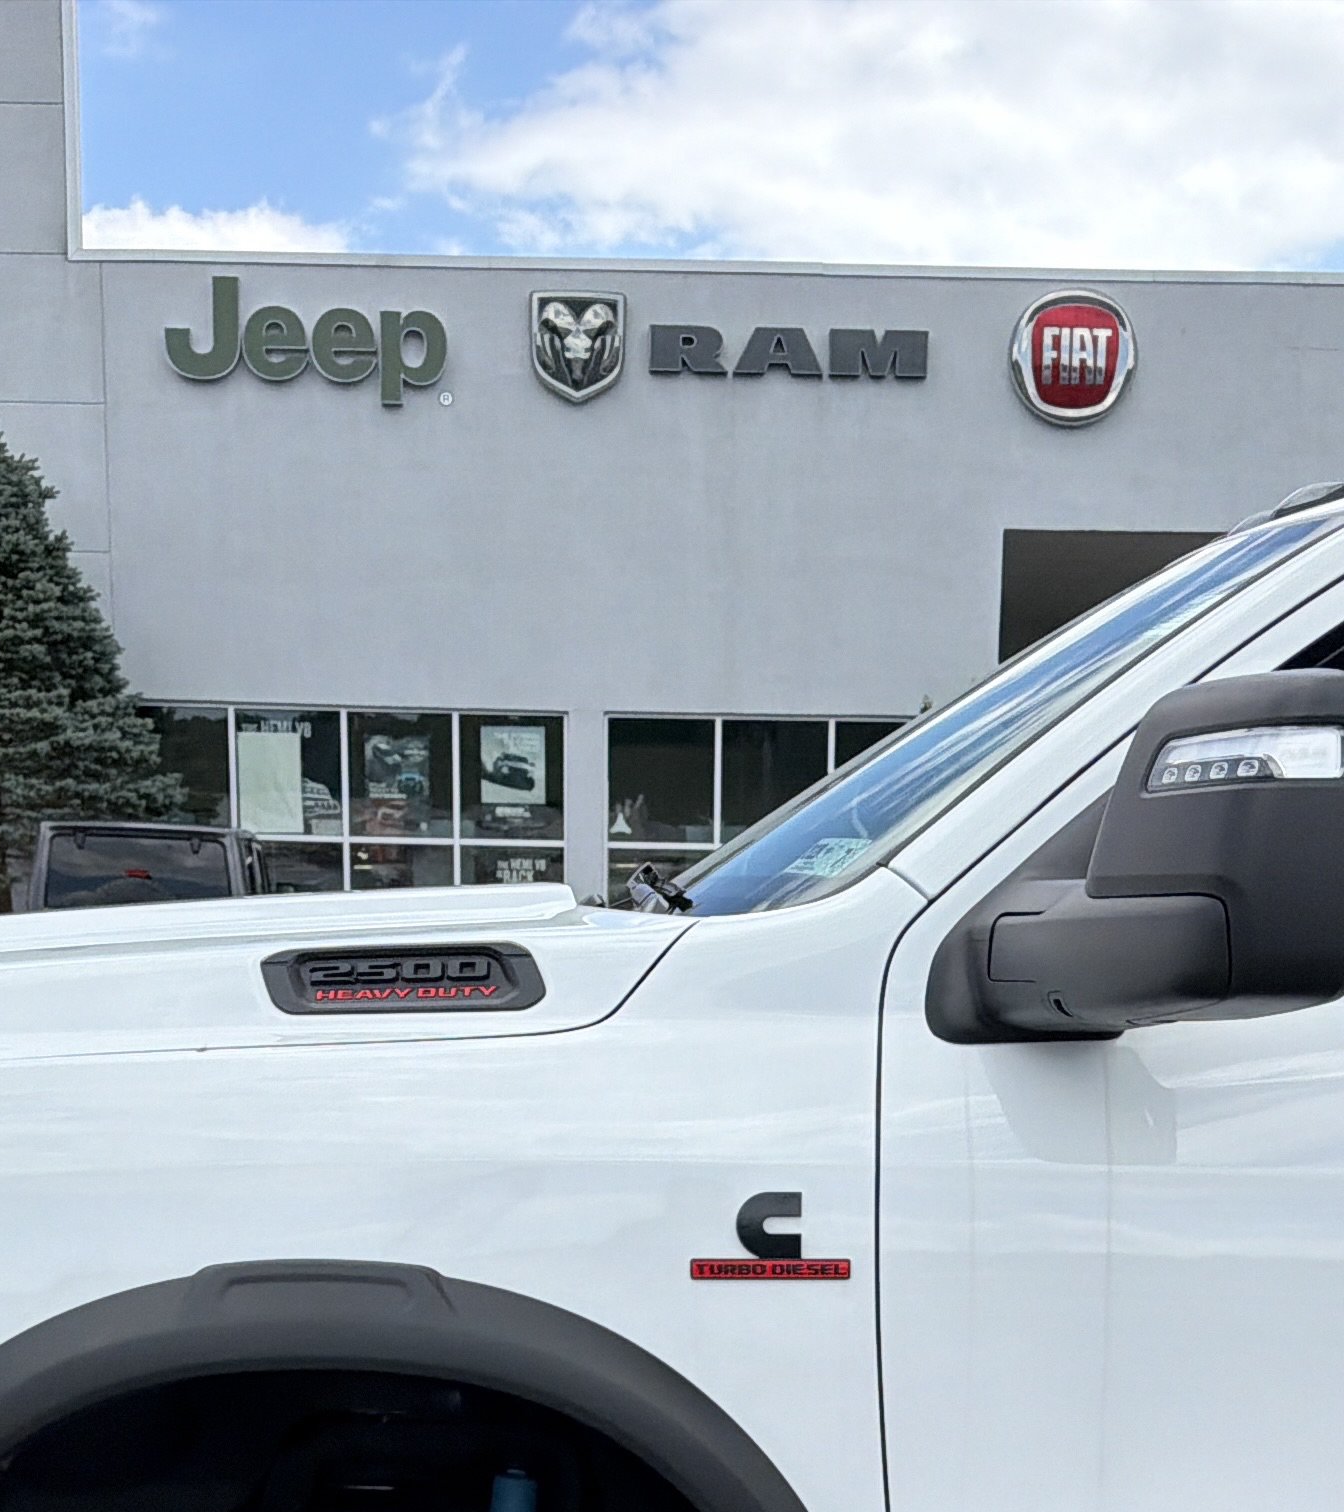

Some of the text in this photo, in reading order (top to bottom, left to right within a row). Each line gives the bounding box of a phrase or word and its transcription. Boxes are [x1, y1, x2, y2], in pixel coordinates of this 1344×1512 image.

[164, 276, 448, 407] Jeep
[649, 324, 929, 379] RAM
[1041, 326, 1113, 385] FIAT
[308, 958, 491, 986] 2500
[315, 985, 497, 1001] HEAVY DUTY
[696, 1263, 848, 1277] TURBO DIESEL
